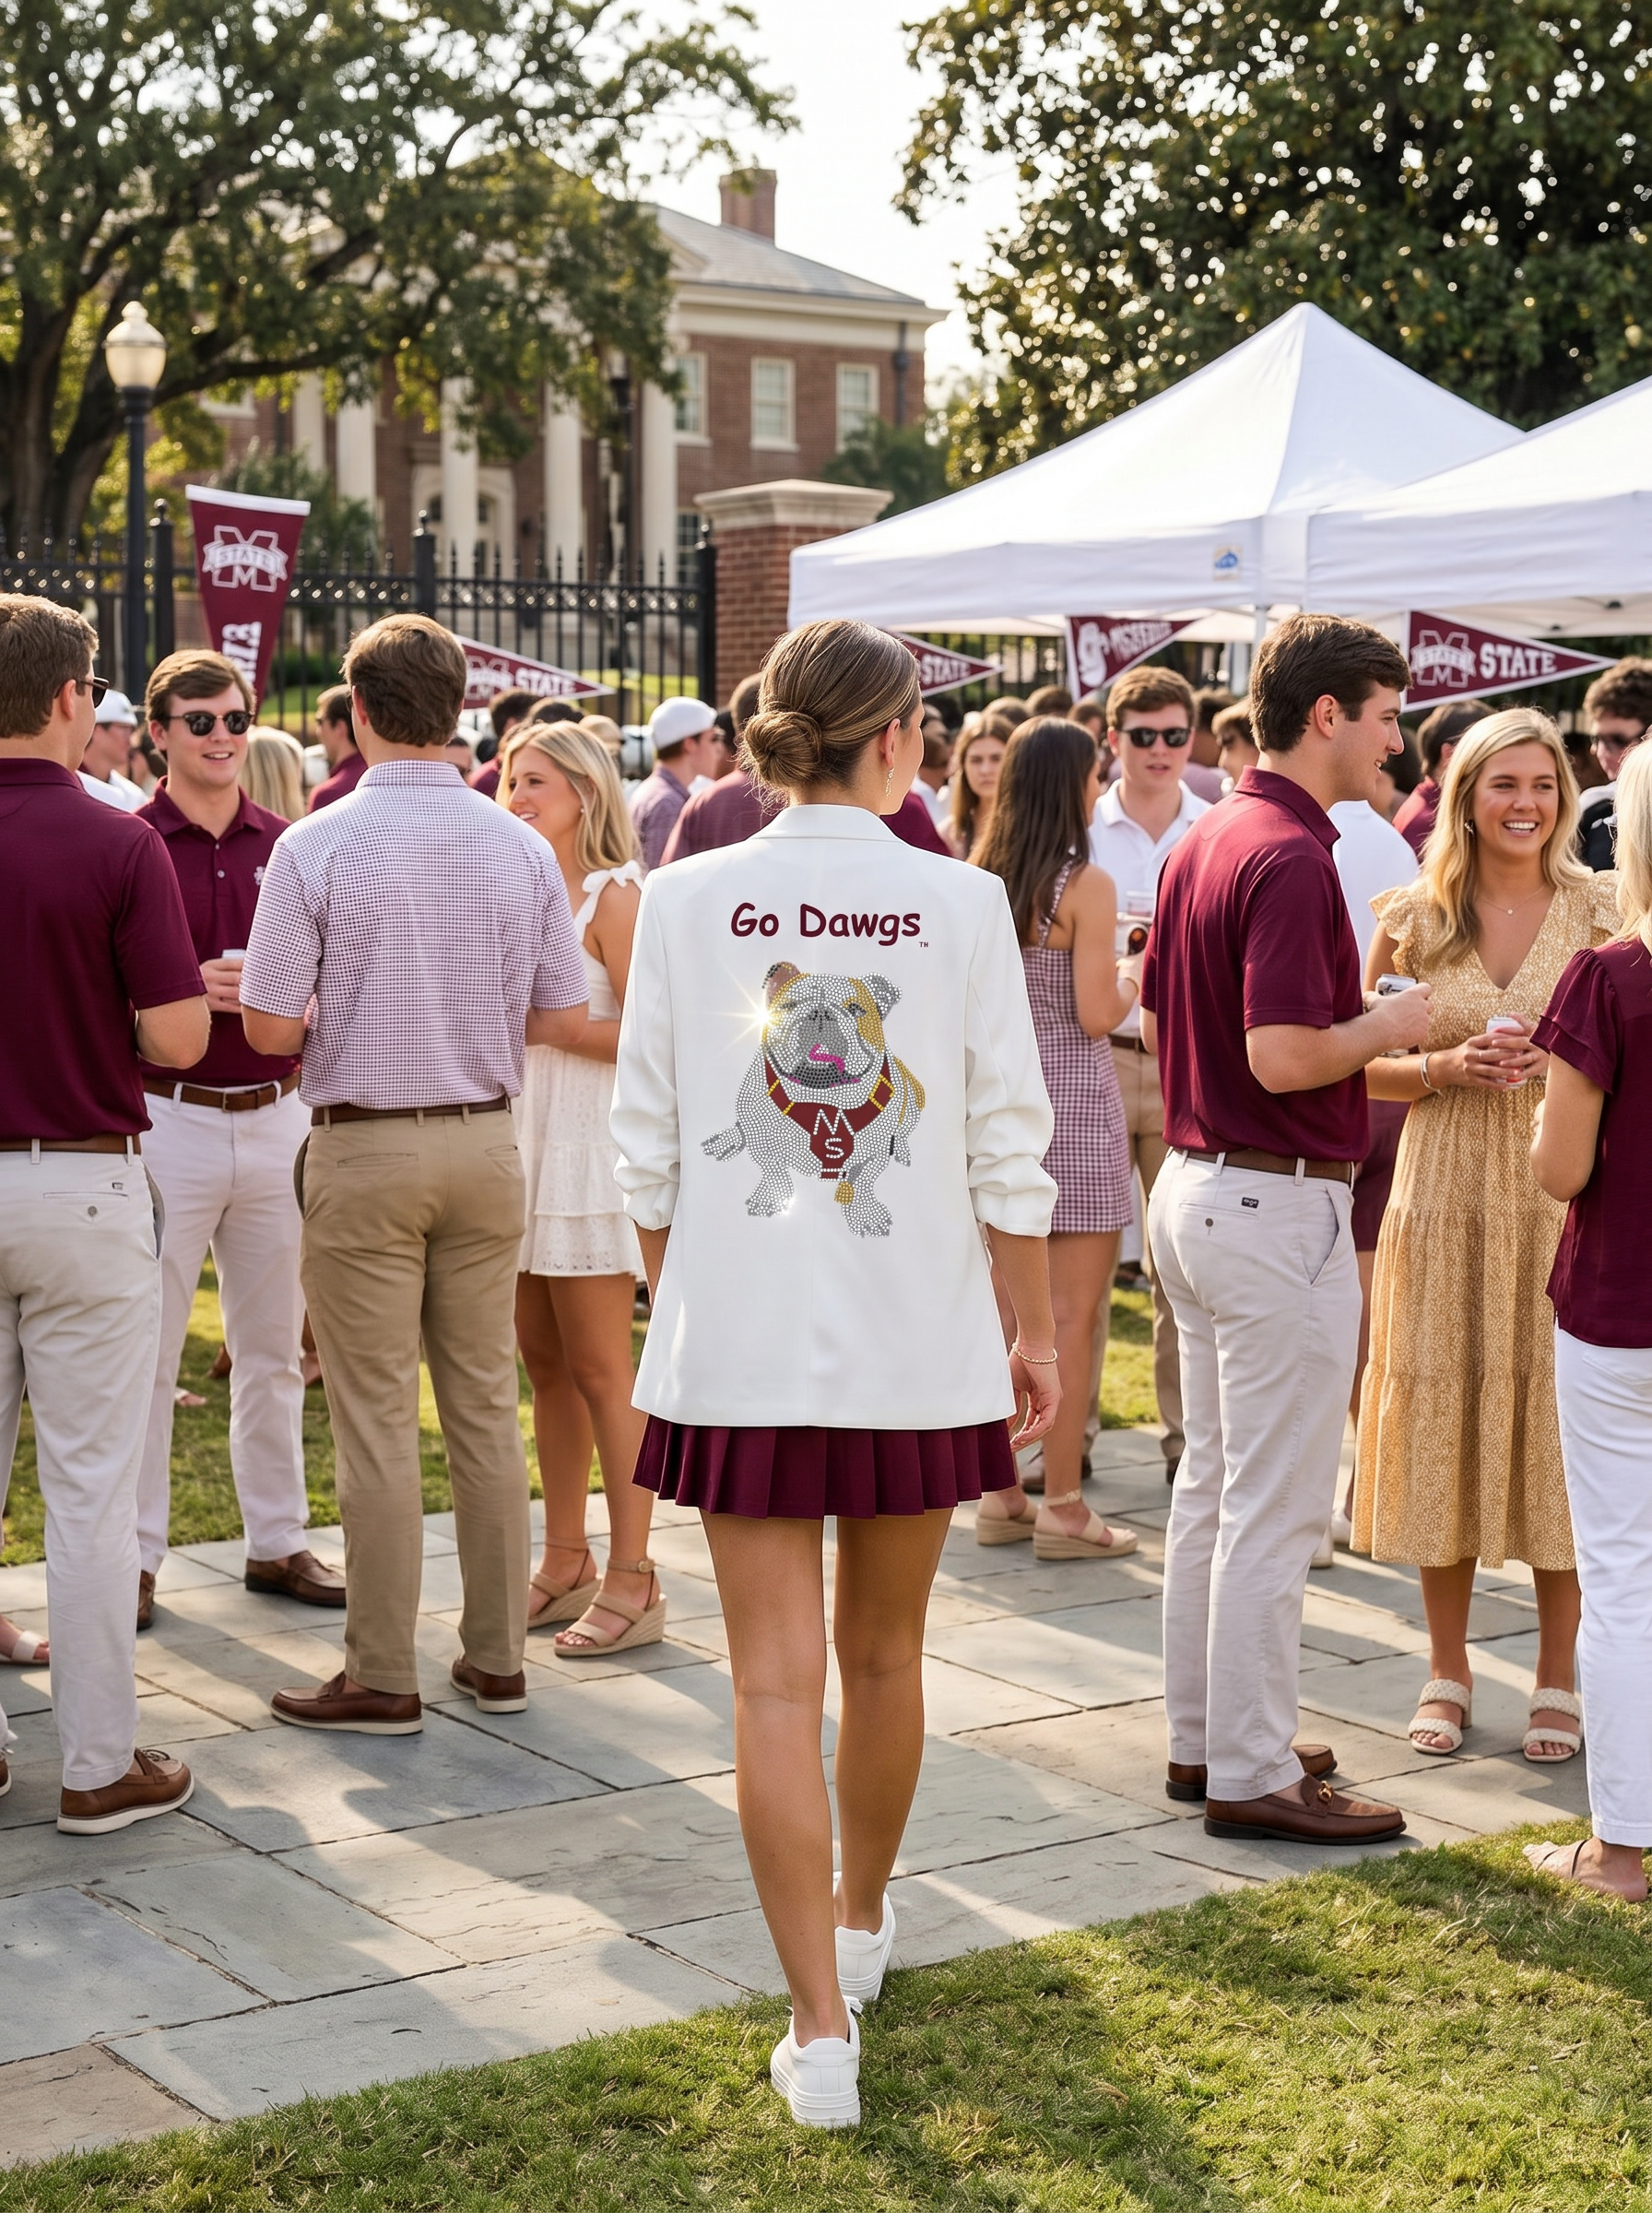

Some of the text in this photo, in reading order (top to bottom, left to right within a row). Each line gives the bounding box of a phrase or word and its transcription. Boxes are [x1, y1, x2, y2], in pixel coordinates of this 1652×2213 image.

[921, 653, 971, 685] STATE
[1480, 642, 1557, 680] STATE
[515, 668, 577, 697] STATE
[730, 902, 921, 946] Go Dawgs
[812, 1108, 855, 1136] M
[824, 1137, 844, 1159] S
